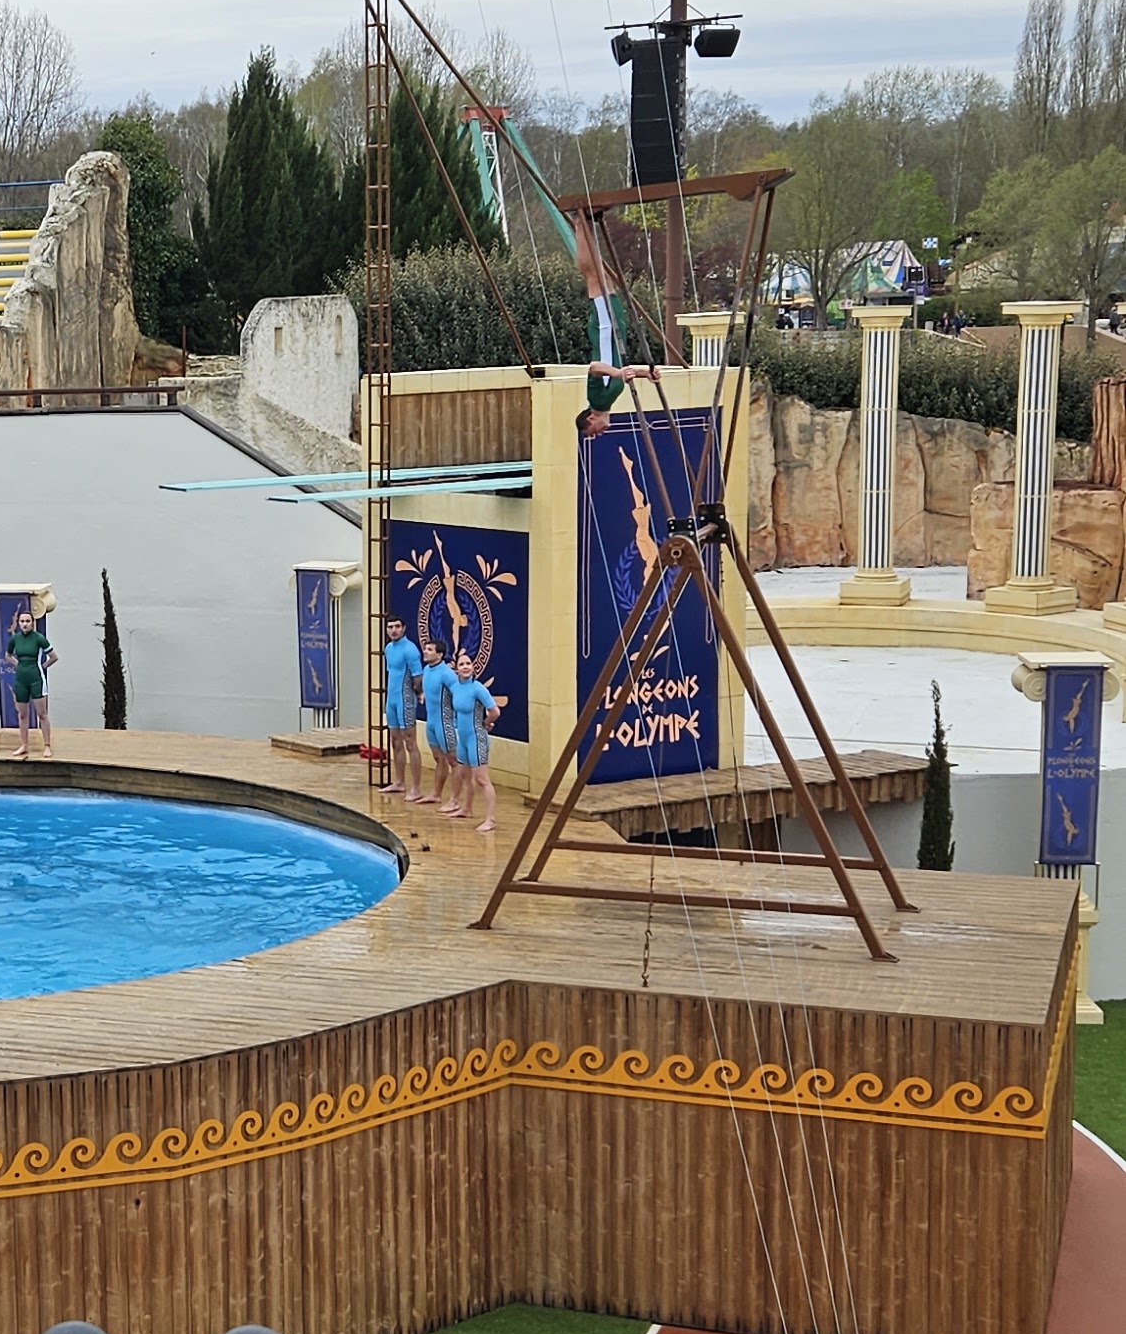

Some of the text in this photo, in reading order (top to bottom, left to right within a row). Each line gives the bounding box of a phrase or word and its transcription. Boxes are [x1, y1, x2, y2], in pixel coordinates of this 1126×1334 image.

[641, 668, 655, 679] LES
[596, 675, 699, 710] LNGEONS
[641, 703, 653, 714] DE
